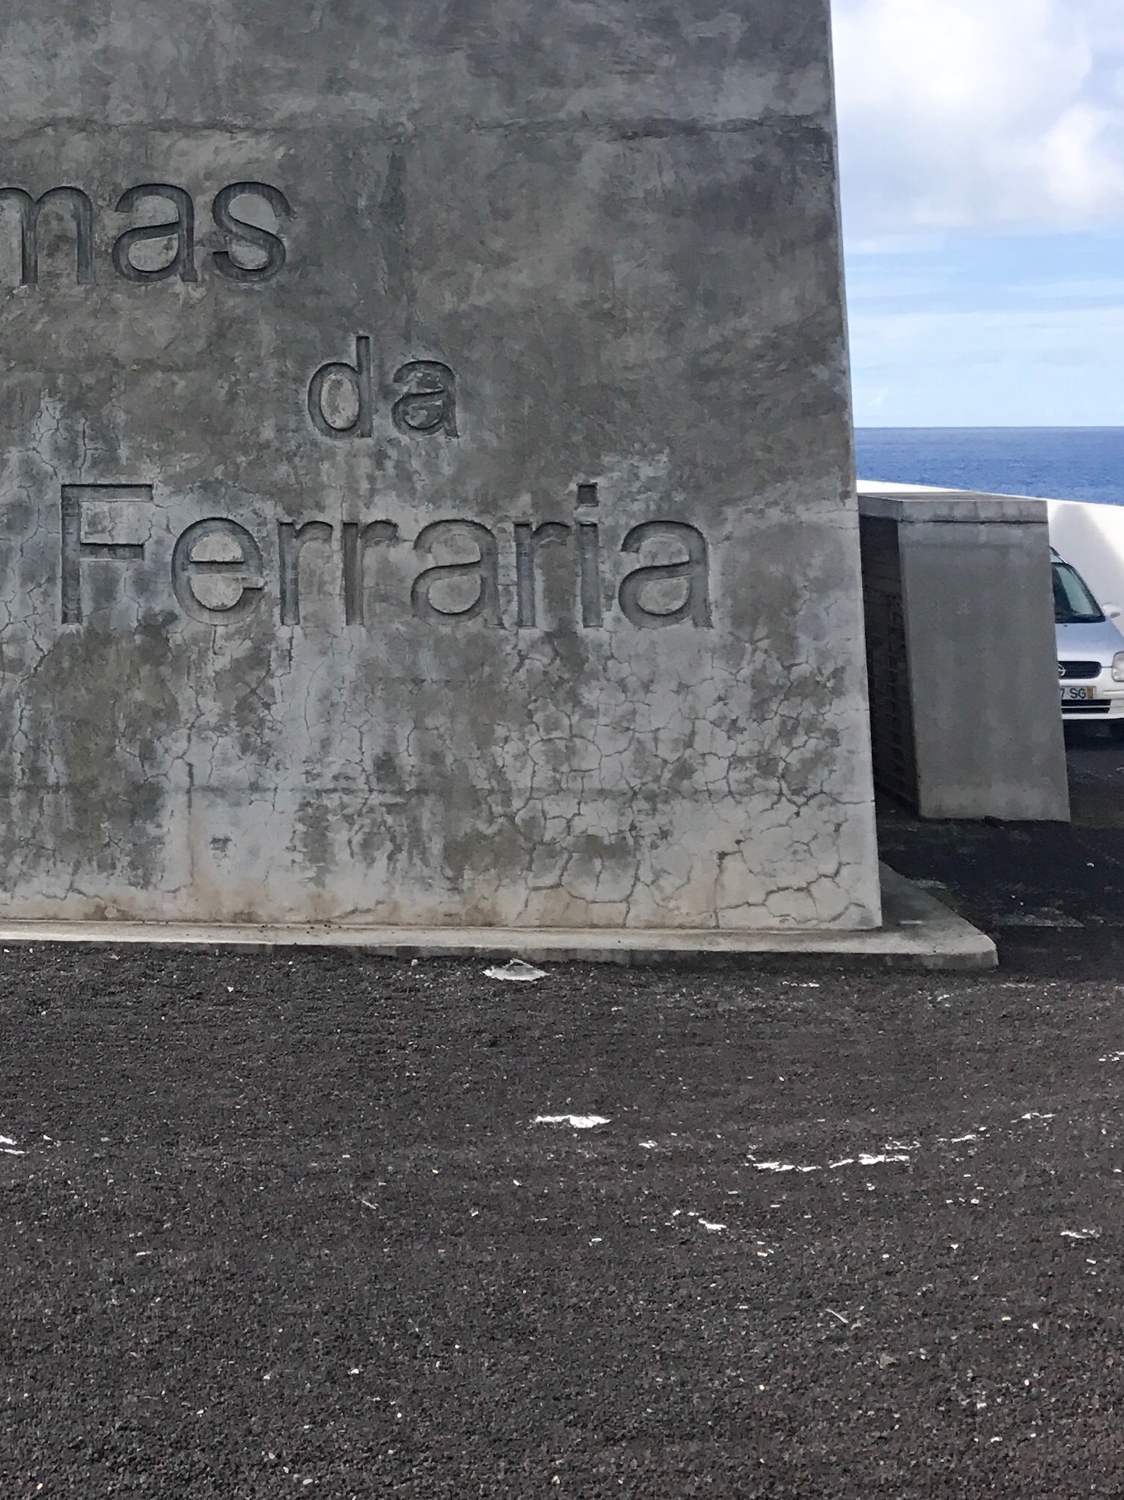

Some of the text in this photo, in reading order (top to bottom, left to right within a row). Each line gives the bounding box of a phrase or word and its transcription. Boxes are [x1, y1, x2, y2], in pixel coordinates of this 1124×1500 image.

[307, 336, 460, 439] da
[60, 483, 714, 628] Ferraria
[1069, 687, 1087, 699] SG
